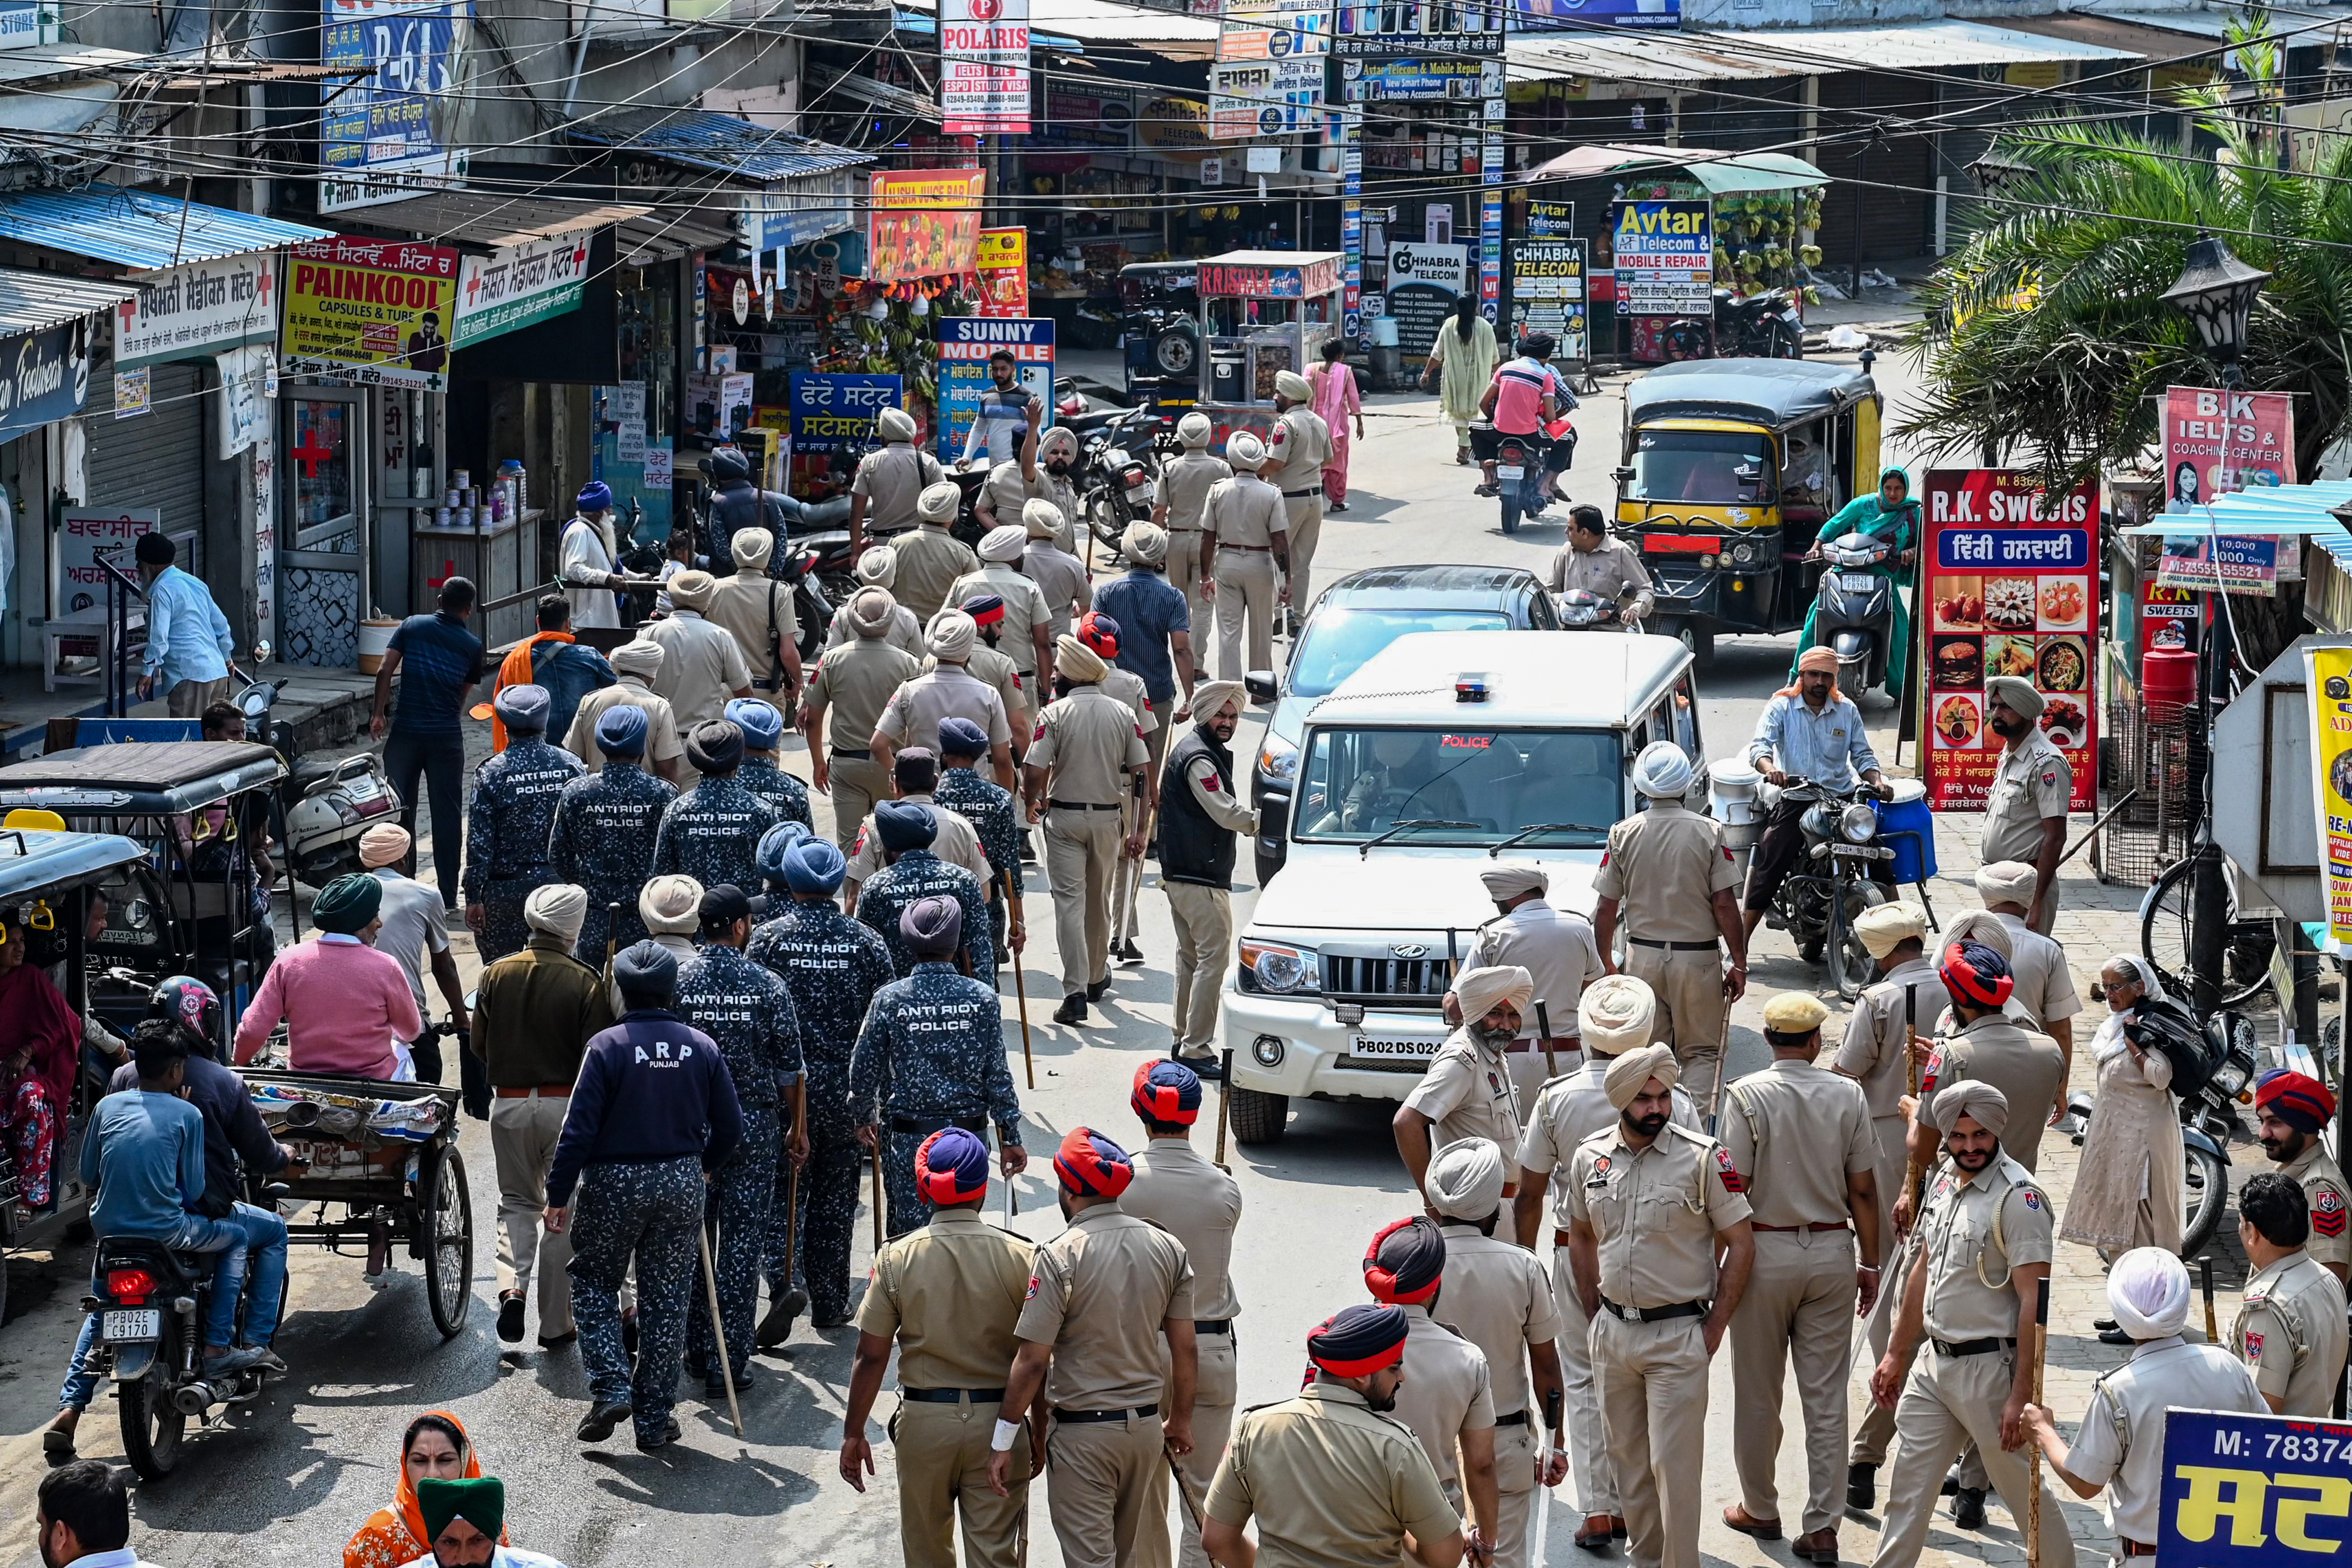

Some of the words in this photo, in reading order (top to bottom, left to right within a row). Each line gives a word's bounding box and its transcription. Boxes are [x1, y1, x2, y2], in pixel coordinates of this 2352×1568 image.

[1280, 1, 1304, 10] MOBILE
[2, 12, 34, 35] STORE
[1225, 23, 1244, 32] MOBILE
[1266, 19, 1292, 28] RECHARGE
[944, 28, 1027, 49] POLARIS
[990, 53, 1027, 61] IMMIGRATION
[958, 66, 982, 76] IELTS
[993, 66, 1010, 76] PTE
[1363, 64, 1385, 76] Avtar
[1388, 63, 1417, 74] Telecom
[1420, 65, 1427, 73] &
[1430, 62, 1454, 74] Mobile
[1457, 63, 1480, 76] Repair
[946, 81, 968, 91] ESPD
[975, 81, 1003, 91] STUDY
[1007, 80, 1027, 91] VISA
[1386, 79, 1399, 87] New
[1402, 79, 1419, 87] Smart
[1421, 78, 1441, 86] Phone
[1088, 87, 1128, 99] RECHARGE
[1388, 91, 1408, 99] Mobile
[1410, 90, 1445, 99] Accessories
[1163, 127, 1203, 140] TELECOM
[1486, 174, 1502, 182] vivo
[888, 186, 915, 205] ALISHA
[919, 186, 944, 204] JUICE
[947, 185, 965, 202] BAR
[1530, 203, 1567, 216] Avtar
[1527, 216, 1570, 229] Telecom
[1621, 205, 1704, 234] Avtar
[1641, 235, 1694, 251] Telecom
[1700, 235, 1709, 250] &
[1514, 248, 1580, 261] CHHABRA
[1399, 255, 1460, 270] CHHABRA
[1619, 255, 1661, 268] MOBILE
[1665, 256, 1706, 268] REPAIR
[1414, 270, 1458, 280] TELECOM
[1514, 262, 1580, 275] TELECOM
[186, 268, 225, 310] ਮੈਡੀਕਲ
[231, 262, 253, 302] ਸਟੋਰ
[296, 264, 441, 311] PAINKOOL
[1202, 267, 1271, 295] KRISHNA
[319, 301, 371, 318] CAPSULES
[375, 309, 383, 319] &
[387, 309, 414, 323] TUBE
[1486, 309, 1495, 318] Jio
[958, 321, 1035, 341] SUNNY
[1348, 321, 1356, 330] Jio
[298, 344, 323, 354] HELPLINE
[335, 348, 372, 360] 86498-86498
[16, 338, 63, 408] Footwear
[362, 366, 380, 383] ਸਟੋਰ
[381, 376, 426, 389] 99145-31214
[800, 377, 835, 406] ਫੋਟੋ
[844, 379, 894, 407] ਸਟੇਟ
[2198, 392, 2256, 420] B.K
[2180, 420, 2256, 442] IELTS
[2263, 432, 2276, 445] &
[650, 451, 667, 466] ਫੋਟੋ
[2173, 443, 2229, 457] COACHING
[2232, 447, 2282, 463] CENTER
[646, 470, 671, 485] ਸਟੇਟ
[1997, 476, 2009, 486] M.
[2214, 468, 2271, 488] IELTS
[1932, 491, 1981, 522] R.K.
[1989, 490, 2086, 522] Sweets
[66, 515, 152, 538] ਬਵਾਸੀਰ
[1952, 534, 1994, 560] ਵਿੱਕੀ
[2003, 534, 2072, 560] ਹਲਵਾਈ
[2220, 540, 2255, 550] 10,000
[2211, 551, 2244, 563] 5000
[2248, 556, 2266, 565] Only
[2227, 588, 2267, 597] AMRITSAR
[2147, 605, 2195, 616] SWEETS
[1441, 735, 1489, 749] POLICE
[1932, 751, 1950, 763] ਇੱਥੇ
[1954, 752, 1982, 764] ਵਿਆਹ
[2082, 752, 2089, 764] ਦੇ
[506, 772, 537, 784] ANTI
[540, 769, 569, 780] RIOT
[1954, 766, 1961, 777] ਤੇ
[516, 783, 563, 795] POLICE
[1944, 783, 1963, 794] ਇੱਥੇ
[585, 805, 616, 814] ANTI
[620, 804, 651, 813] RIOT
[596, 819, 643, 827] POLICE
[678, 814, 714, 822] ANTI
[718, 813, 751, 822] RIOT
[298, 825, 320, 834] Activa
[688, 827, 741, 836] POLICE
[2335, 848, 2350, 859] VIDE
[882, 882, 920, 895] ANTI
[924, 879, 959, 891] RIOT
[779, 942, 818, 953] ANTI
[821, 942, 859, 953] RIOT
[789, 958, 849, 969] POLICE
[681, 994, 720, 1005] ANTI
[722, 994, 761, 1005] RIOT
[692, 1011, 751, 1021] POLICE
[897, 1004, 938, 1017] ANTI
[942, 1003, 981, 1015] RIOT
[909, 1020, 970, 1031] POLICE
[1357, 1040, 1393, 1053] PB02
[1396, 1042, 1415, 1054] DS
[113, 1311, 148, 1325] PB02E
[112, 1324, 148, 1337] C9170
[2214, 1430, 2251, 1457] M:
